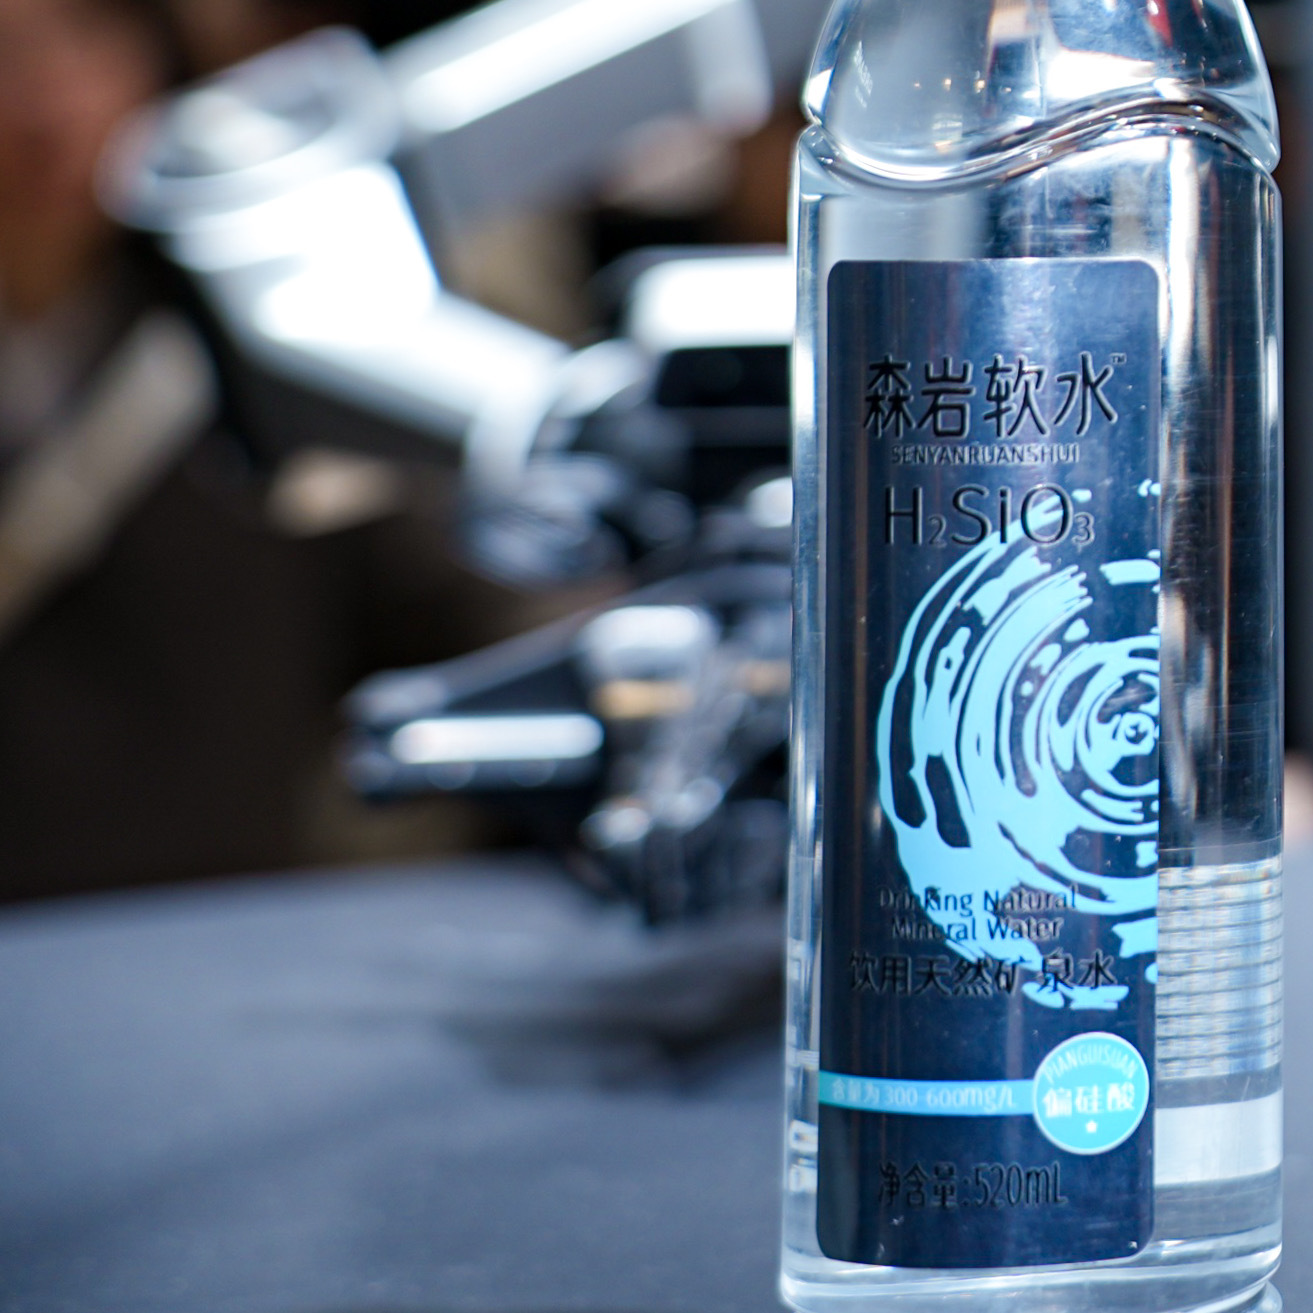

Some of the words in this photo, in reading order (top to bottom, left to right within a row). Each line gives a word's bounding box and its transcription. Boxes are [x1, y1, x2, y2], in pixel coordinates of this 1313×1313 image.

[863, 352, 1119, 438] 森岩软水
[891, 443, 1081, 466] SENYANRUANSHUI
[879, 885, 975, 917] Drinking
[983, 884, 1078, 911] Natural
[891, 915, 977, 941] Mineral
[987, 916, 1065, 941] Water
[850, 946, 1119, 997] 饮用天然矿泉水
[1043, 1081, 1136, 1118] 偏硅酸
